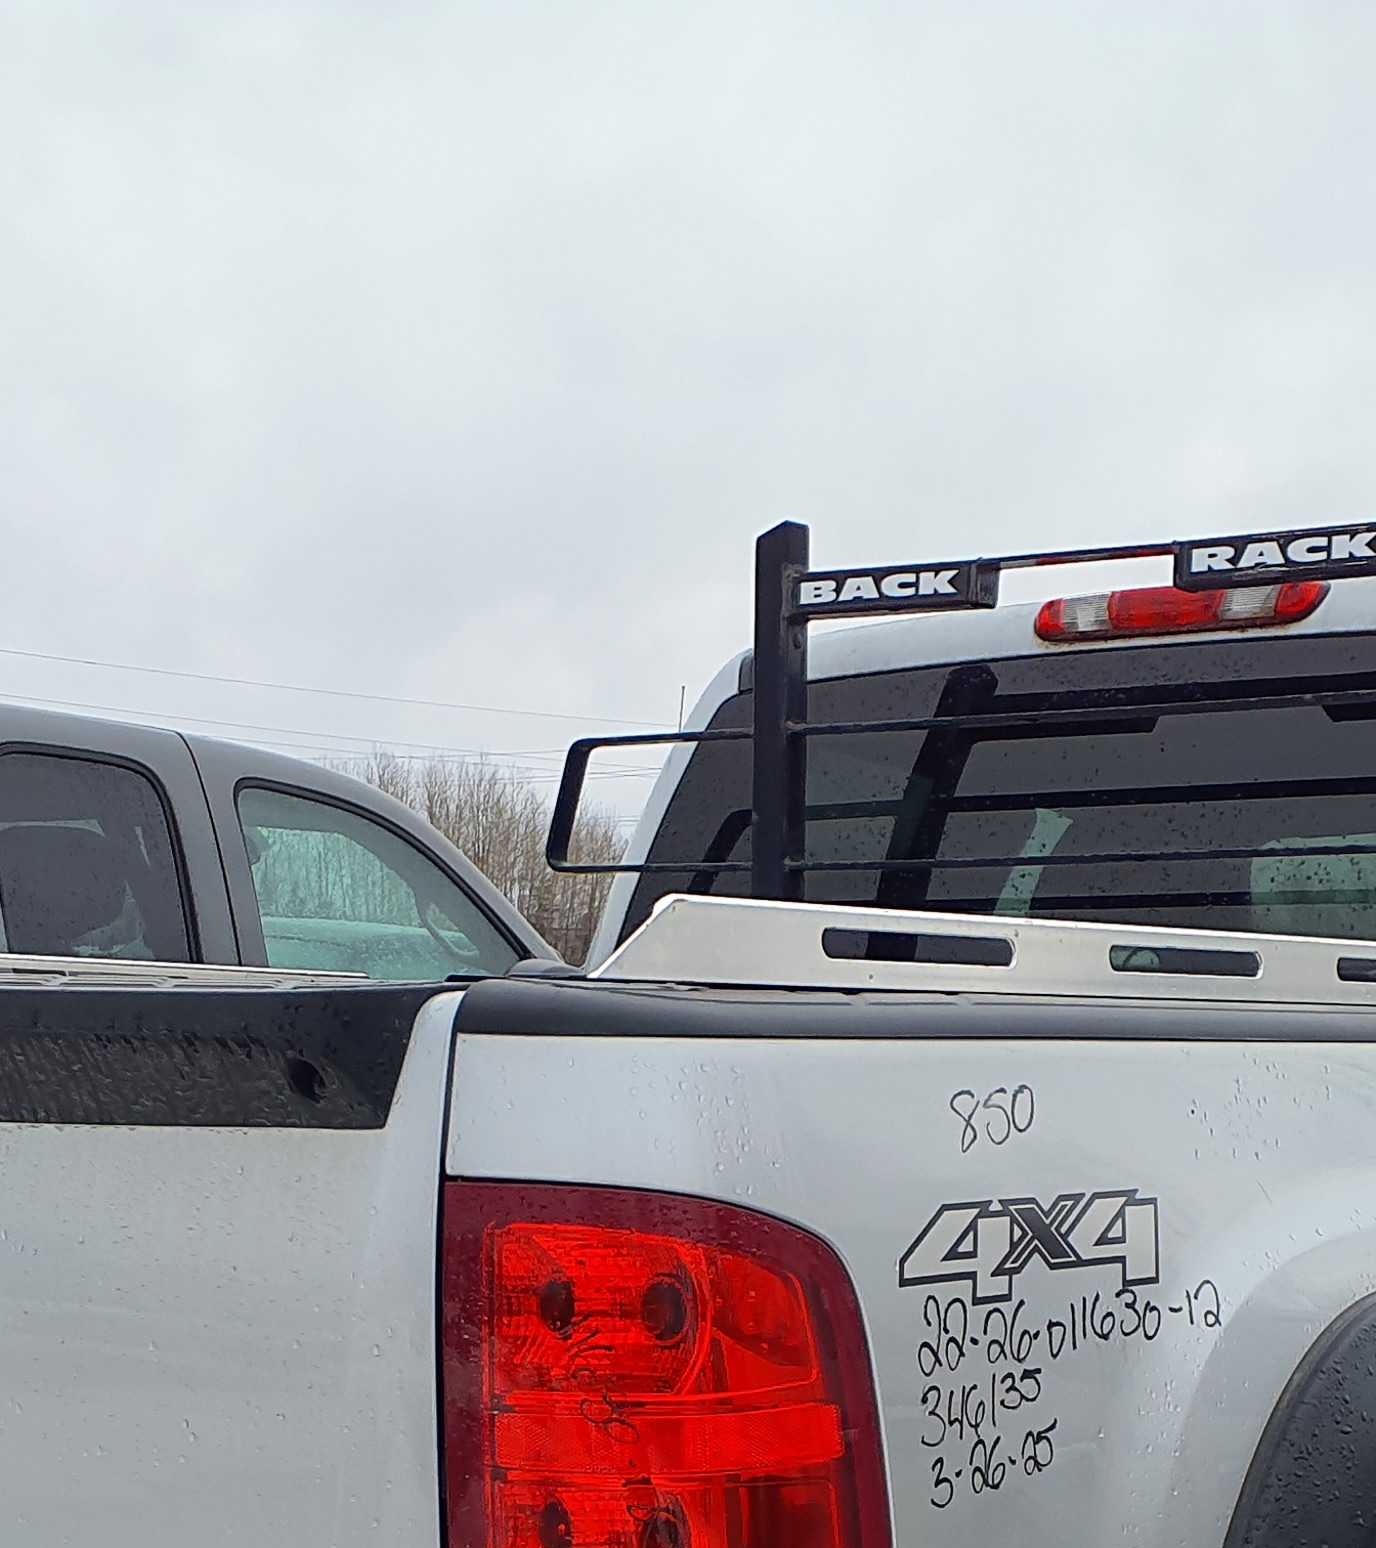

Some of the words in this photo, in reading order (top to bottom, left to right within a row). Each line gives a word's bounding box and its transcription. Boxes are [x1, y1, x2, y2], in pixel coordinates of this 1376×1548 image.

[799, 569, 960, 606] BACK
[950, 1084, 1035, 1154] 850
[920, 1367, 1042, 1448] 346135
